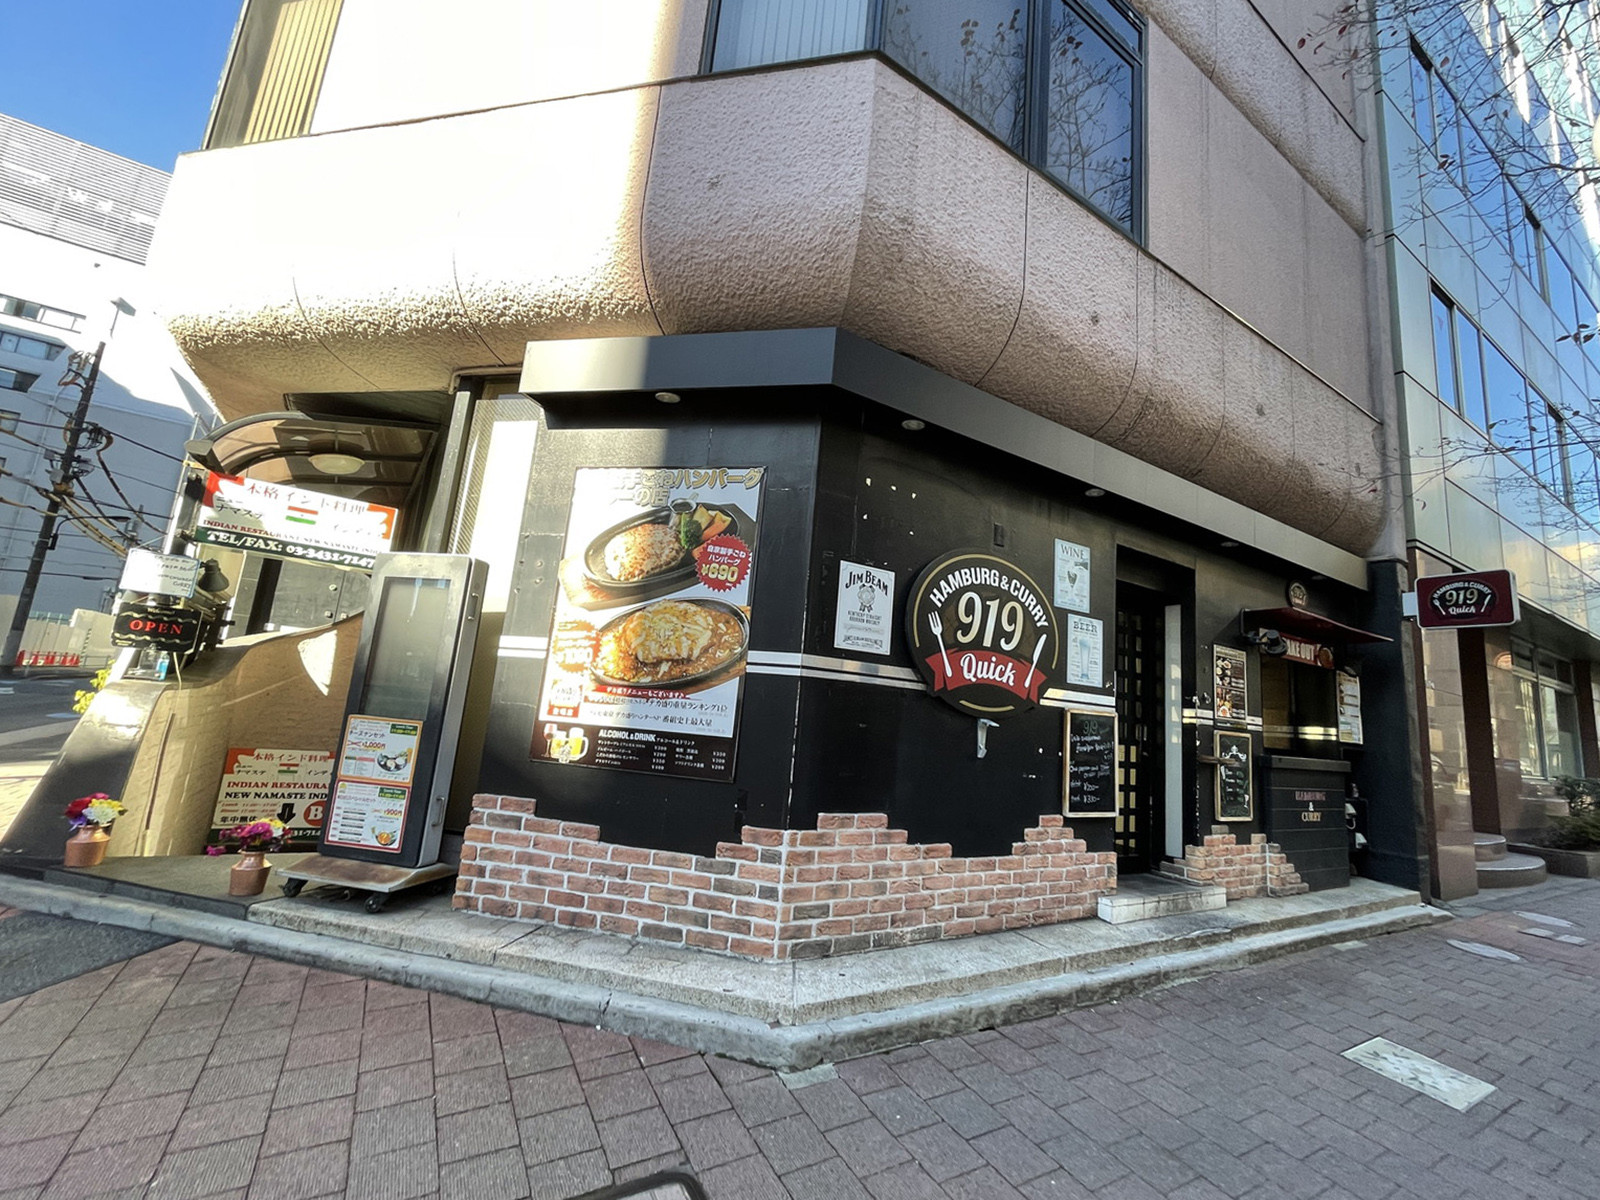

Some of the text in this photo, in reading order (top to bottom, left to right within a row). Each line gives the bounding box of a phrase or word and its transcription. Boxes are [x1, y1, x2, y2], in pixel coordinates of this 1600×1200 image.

[203, 519, 239, 531] INDIAN
[285, 545, 376, 569] 03-3431-7147
[1060, 543, 1084, 560] WINE
[708, 554, 741, 567] ハンバーグ
[701, 562, 739, 583] ¥690
[845, 570, 888, 596] JIM BEAM
[1432, 582, 1464, 598] HAMBURG
[1469, 581, 1492, 594] CURRY
[929, 567, 1000, 608] HAMBURG
[1009, 579, 1049, 627] CURRY
[1445, 588, 1478, 606] 919
[1448, 605, 1476, 615] Quick
[129, 619, 183, 635] OPEN
[956, 591, 1024, 651] 919
[1073, 620, 1098, 634] BEER
[960, 653, 1017, 687] Quick
[599, 729, 630, 739] ALCOHOL
[634, 733, 656, 742] DRINK
[226, 781, 269, 789] INDIAN
[224, 791, 253, 799] NEW
[253, 792, 307, 800] NAMASTE
